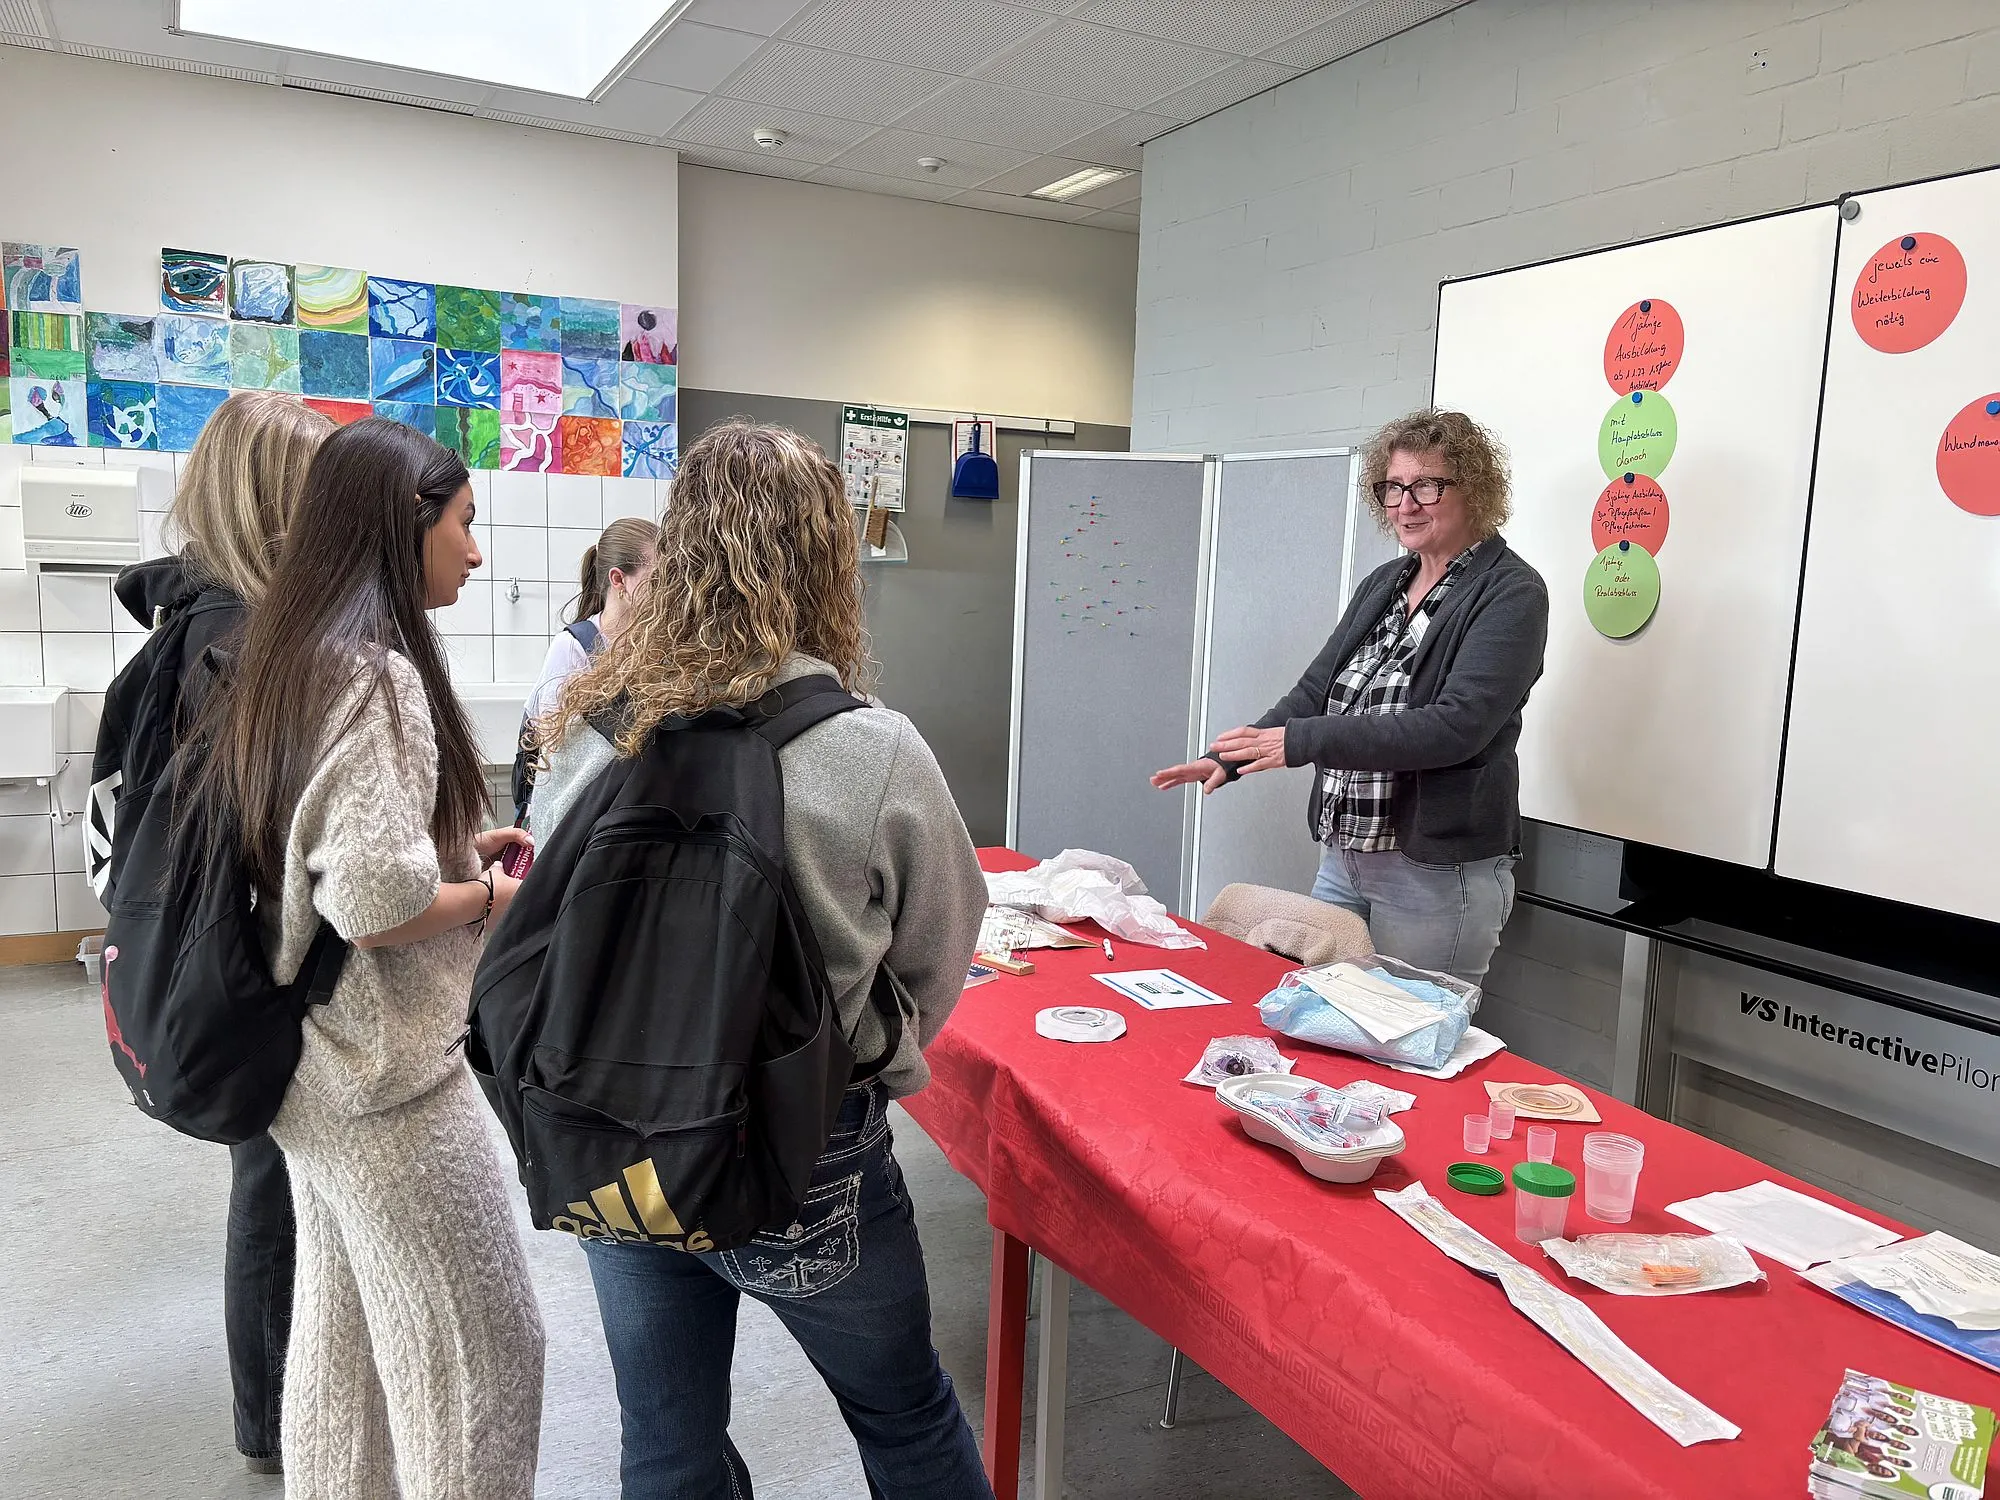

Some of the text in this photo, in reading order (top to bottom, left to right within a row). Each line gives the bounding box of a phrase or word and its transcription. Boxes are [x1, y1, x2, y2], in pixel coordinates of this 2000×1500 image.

[1868, 252, 1940, 284] jeweils eine
[1857, 285, 1931, 309] Weiterbildung
[1875, 311, 1905, 328] nötig
[1614, 341, 1667, 362] Ausbildung
[1628, 379, 1658, 391] Ausbildung
[1609, 413, 1626, 428] mit
[1944, 431, 2000, 452] Wundmana
[1615, 448, 1647, 468] danach
[1631, 487, 1664, 503] Ausbildung
[1614, 572, 1631, 583] oder
[1594, 584, 1638, 597] Realabschluss
